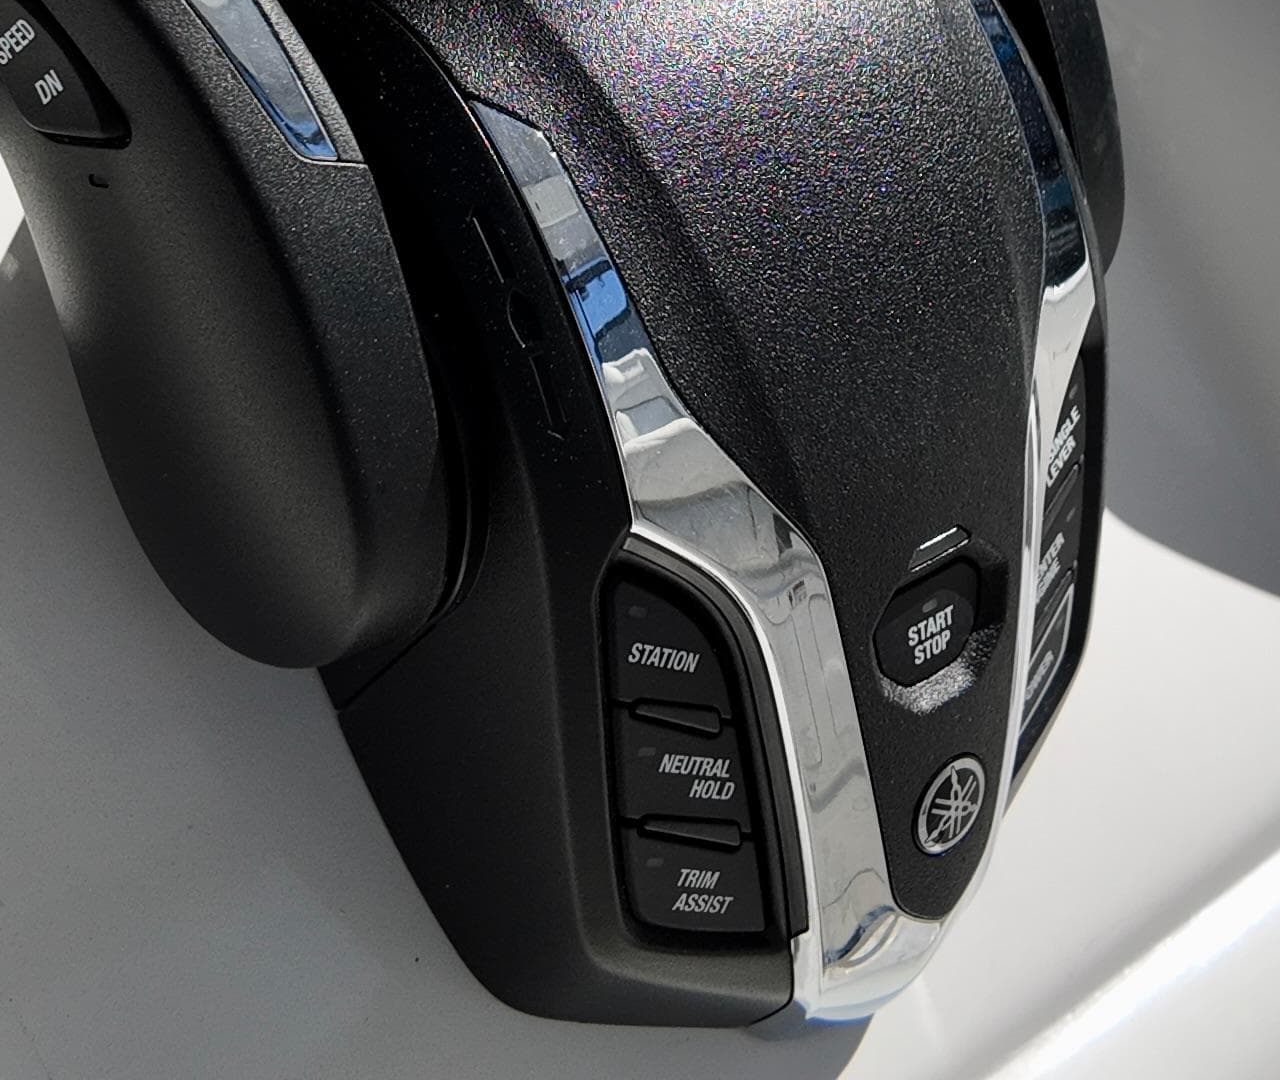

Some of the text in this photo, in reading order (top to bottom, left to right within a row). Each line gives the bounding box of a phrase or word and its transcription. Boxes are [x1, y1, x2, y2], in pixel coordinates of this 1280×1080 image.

[35, 70, 63, 105] DN
[1047, 435, 1076, 488] LEVER
[907, 605, 954, 648] START
[628, 642, 700, 674] STATION
[914, 630, 952, 666] STOP
[659, 753, 730, 779] NEUTRAL
[689, 778, 735, 801] HOLD
[676, 868, 720, 889] TRIM
[672, 894, 733, 915] ASSIST
